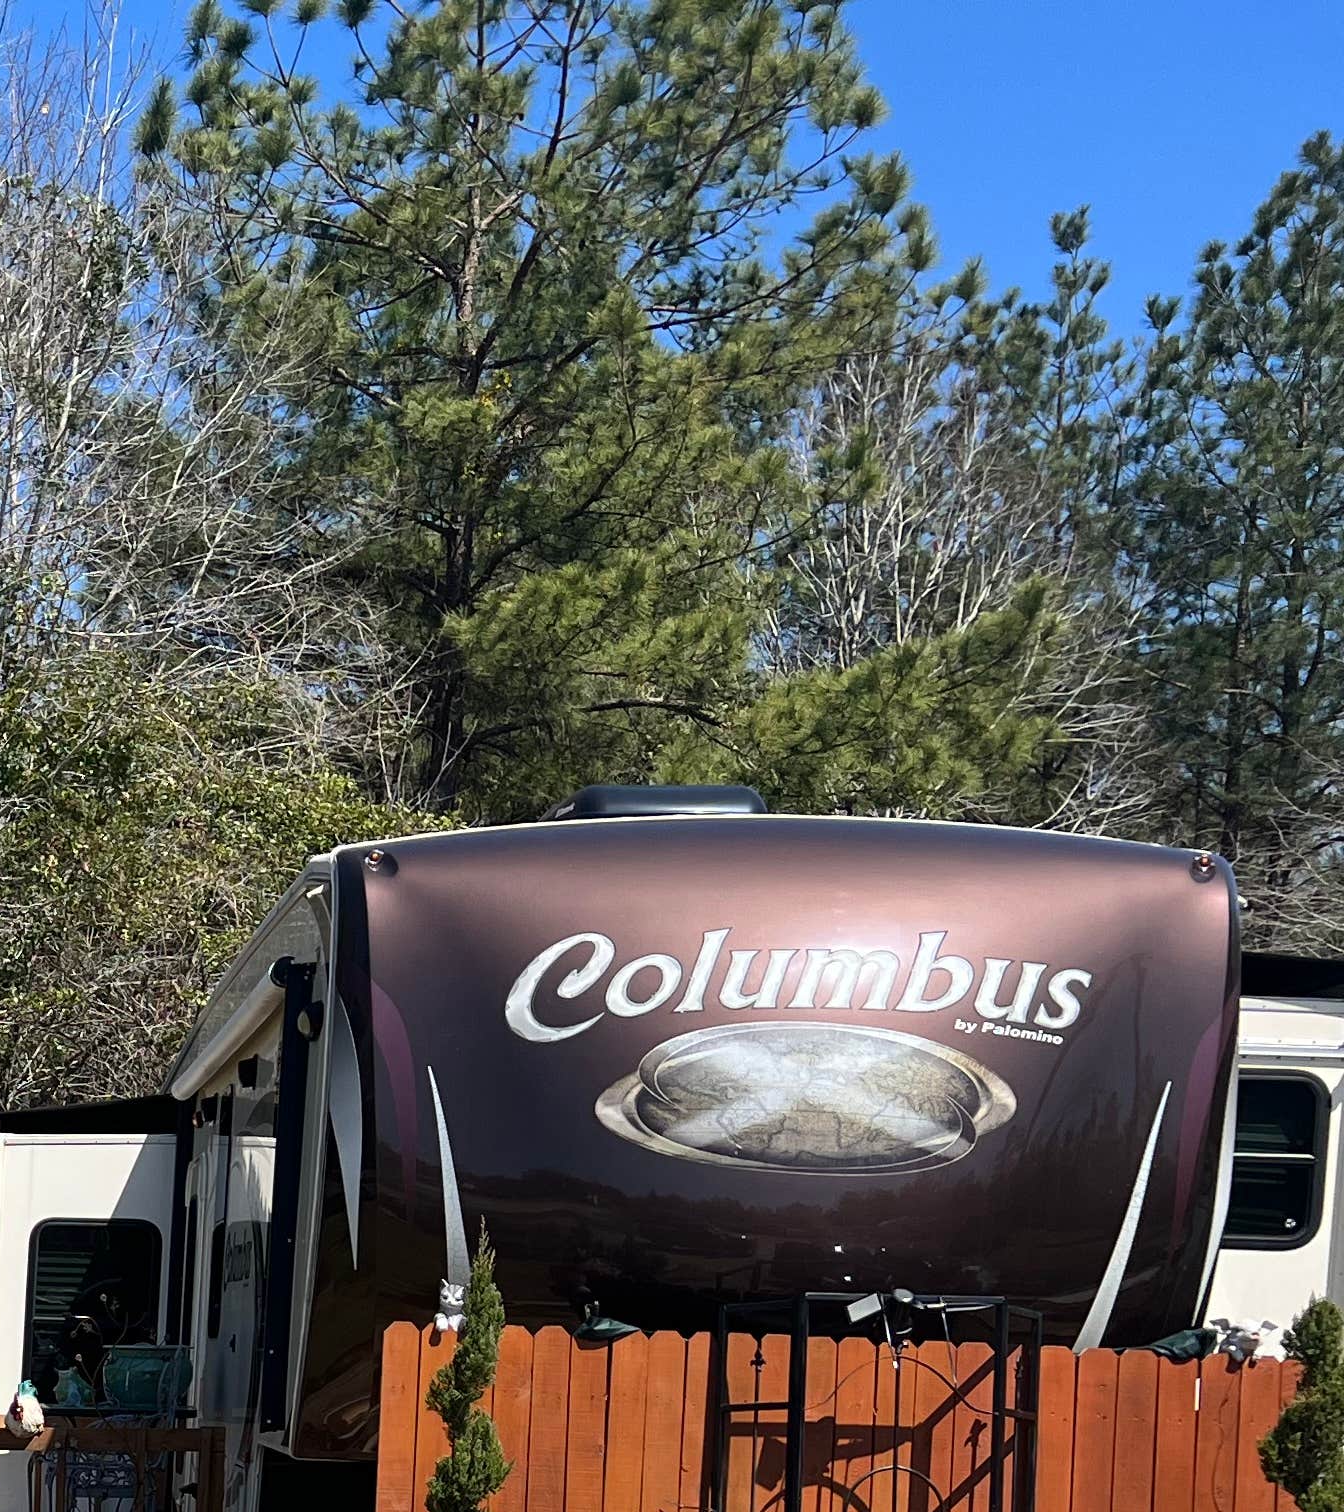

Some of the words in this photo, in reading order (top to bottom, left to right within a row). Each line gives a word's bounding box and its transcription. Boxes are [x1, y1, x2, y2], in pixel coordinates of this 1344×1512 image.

[505, 927, 1093, 1042] Columbus
[954, 1019, 977, 1033] by
[981, 1021, 1064, 1044] Palomino
